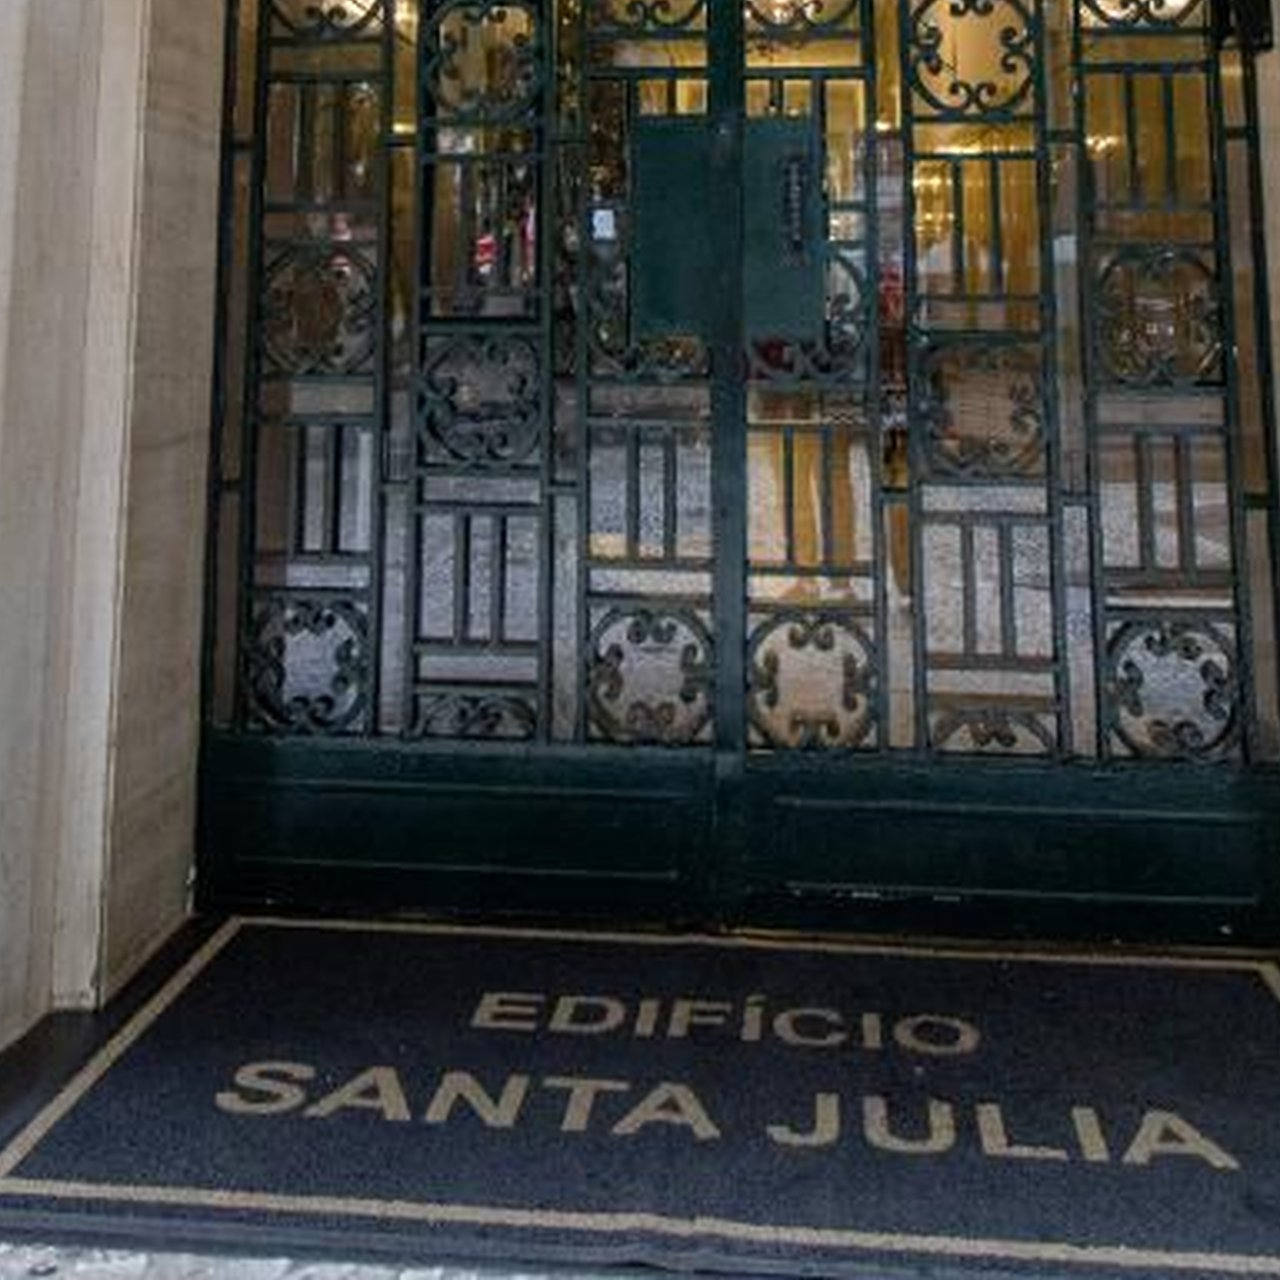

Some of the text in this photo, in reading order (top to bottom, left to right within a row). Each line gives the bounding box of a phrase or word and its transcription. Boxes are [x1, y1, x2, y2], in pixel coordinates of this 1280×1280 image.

[471, 993, 980, 1055] EDIFÍCIO
[215, 1062, 1240, 1171] SANTA JULIA
